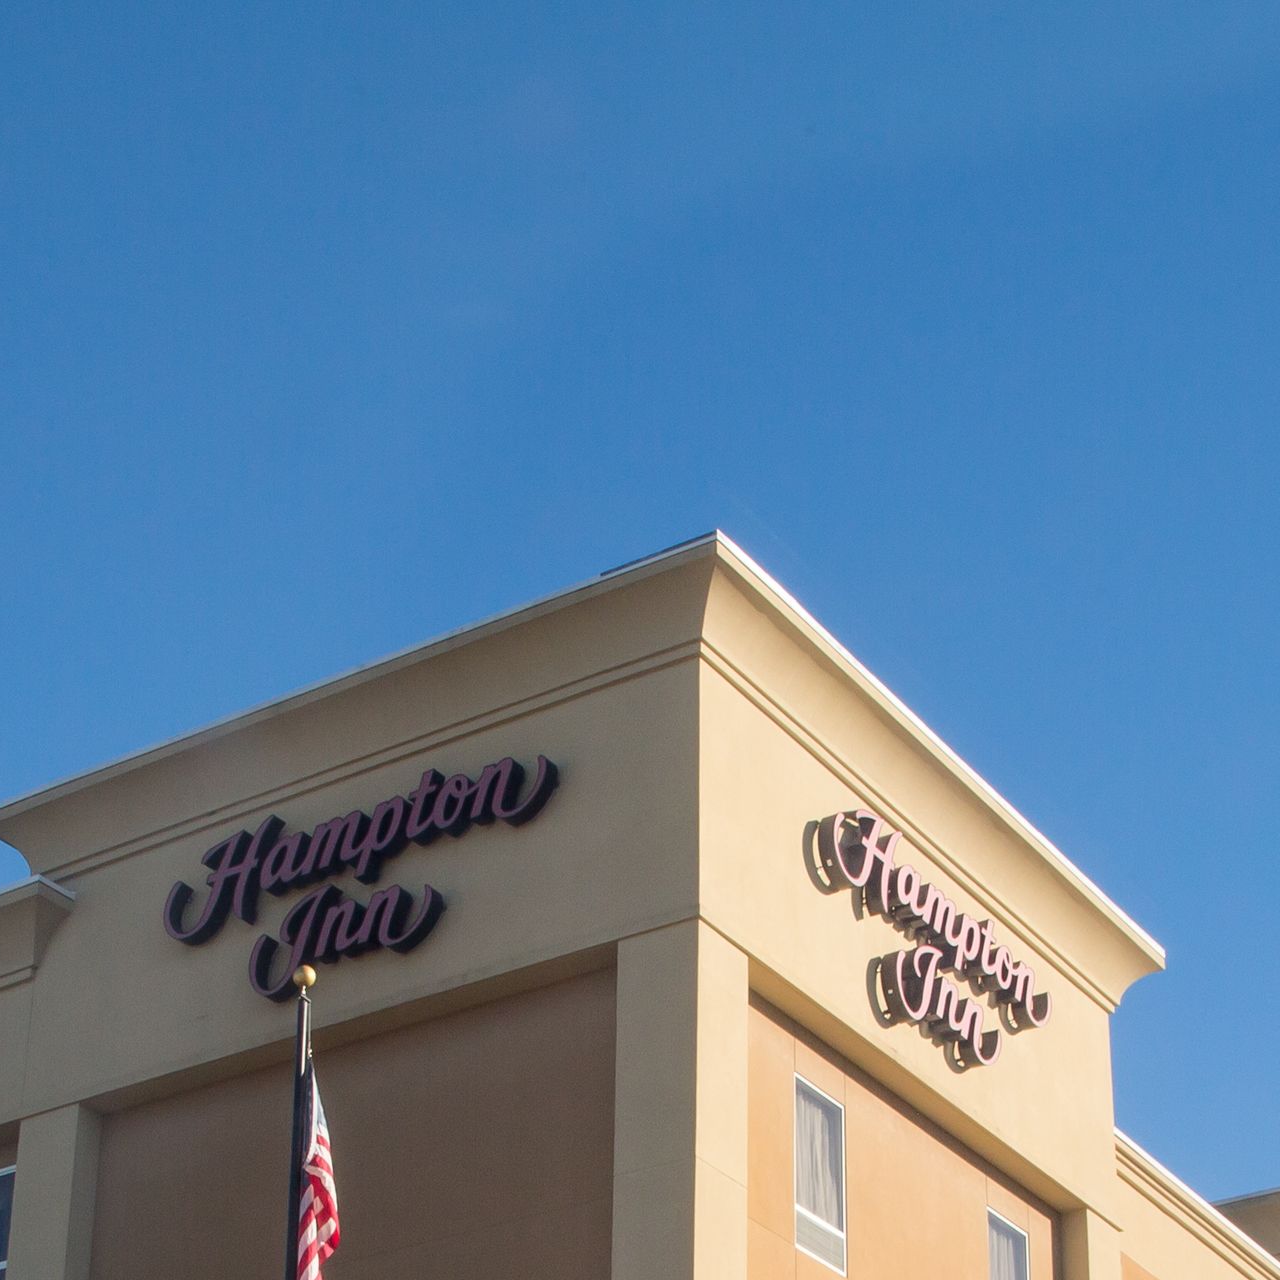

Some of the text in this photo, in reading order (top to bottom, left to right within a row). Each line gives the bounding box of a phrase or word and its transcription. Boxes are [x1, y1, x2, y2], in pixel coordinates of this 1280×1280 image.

[163, 754, 558, 946] Hampton
[828, 809, 1053, 1030] Hampton
[248, 884, 447, 1002] Inn
[890, 944, 1002, 1067] Inn
